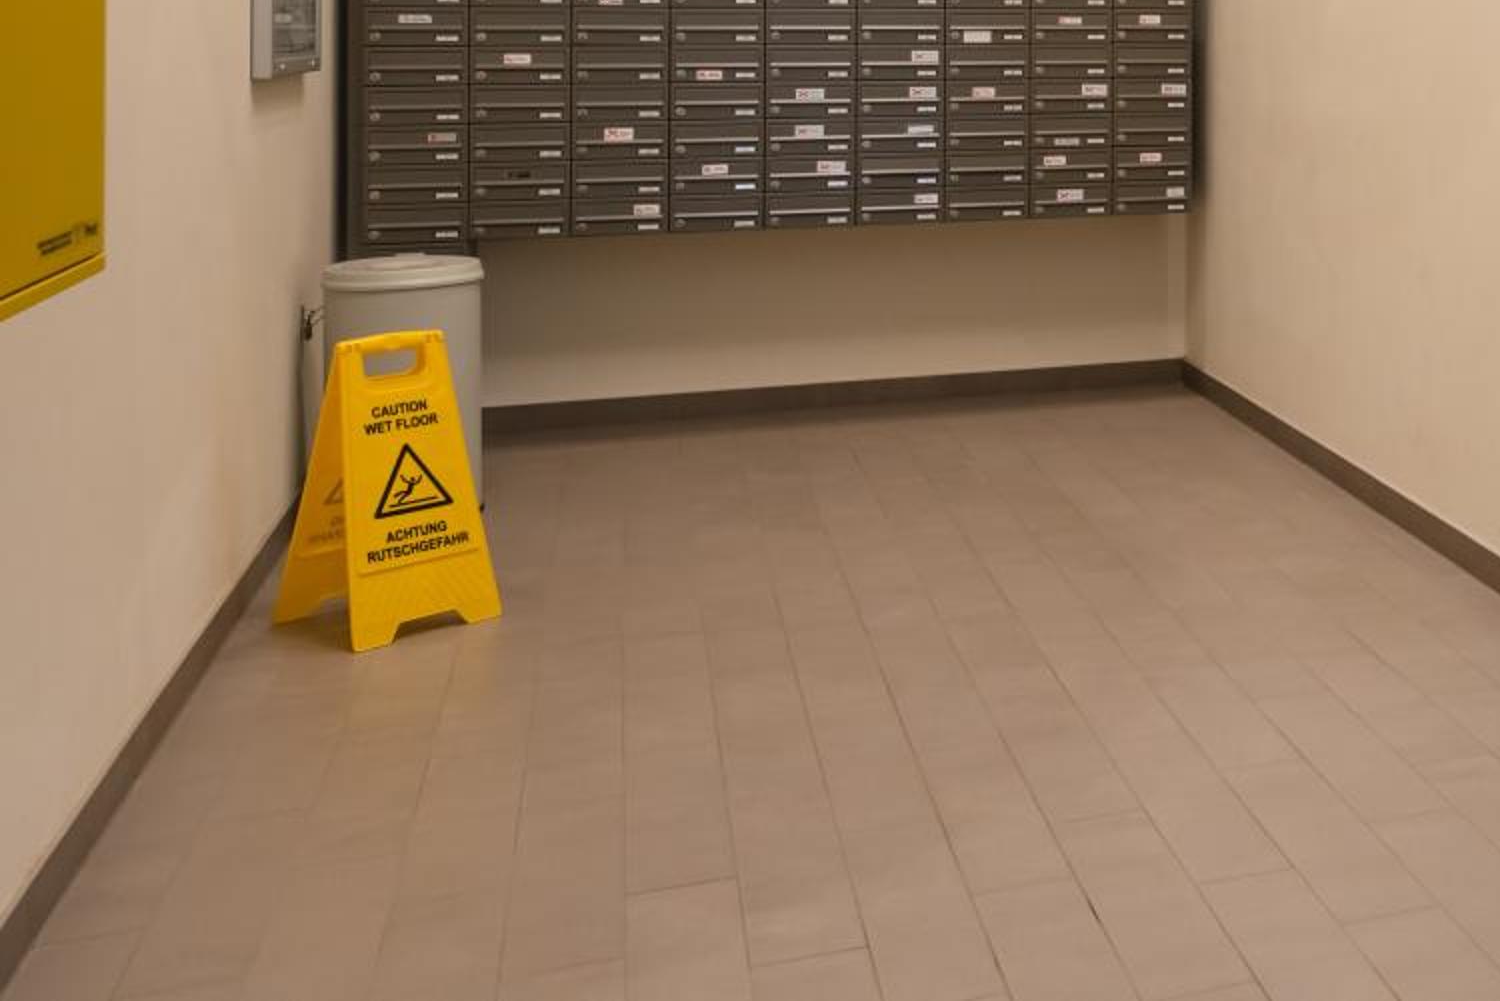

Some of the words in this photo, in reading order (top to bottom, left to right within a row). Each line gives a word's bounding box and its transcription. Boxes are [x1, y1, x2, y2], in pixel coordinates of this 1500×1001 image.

[371, 399, 428, 419] CAUTION
[363, 420, 392, 436] WET
[396, 412, 439, 430] FLOOR
[386, 520, 448, 543] ACHTUNG
[367, 531, 470, 564] RUTSCHGEFAHR
